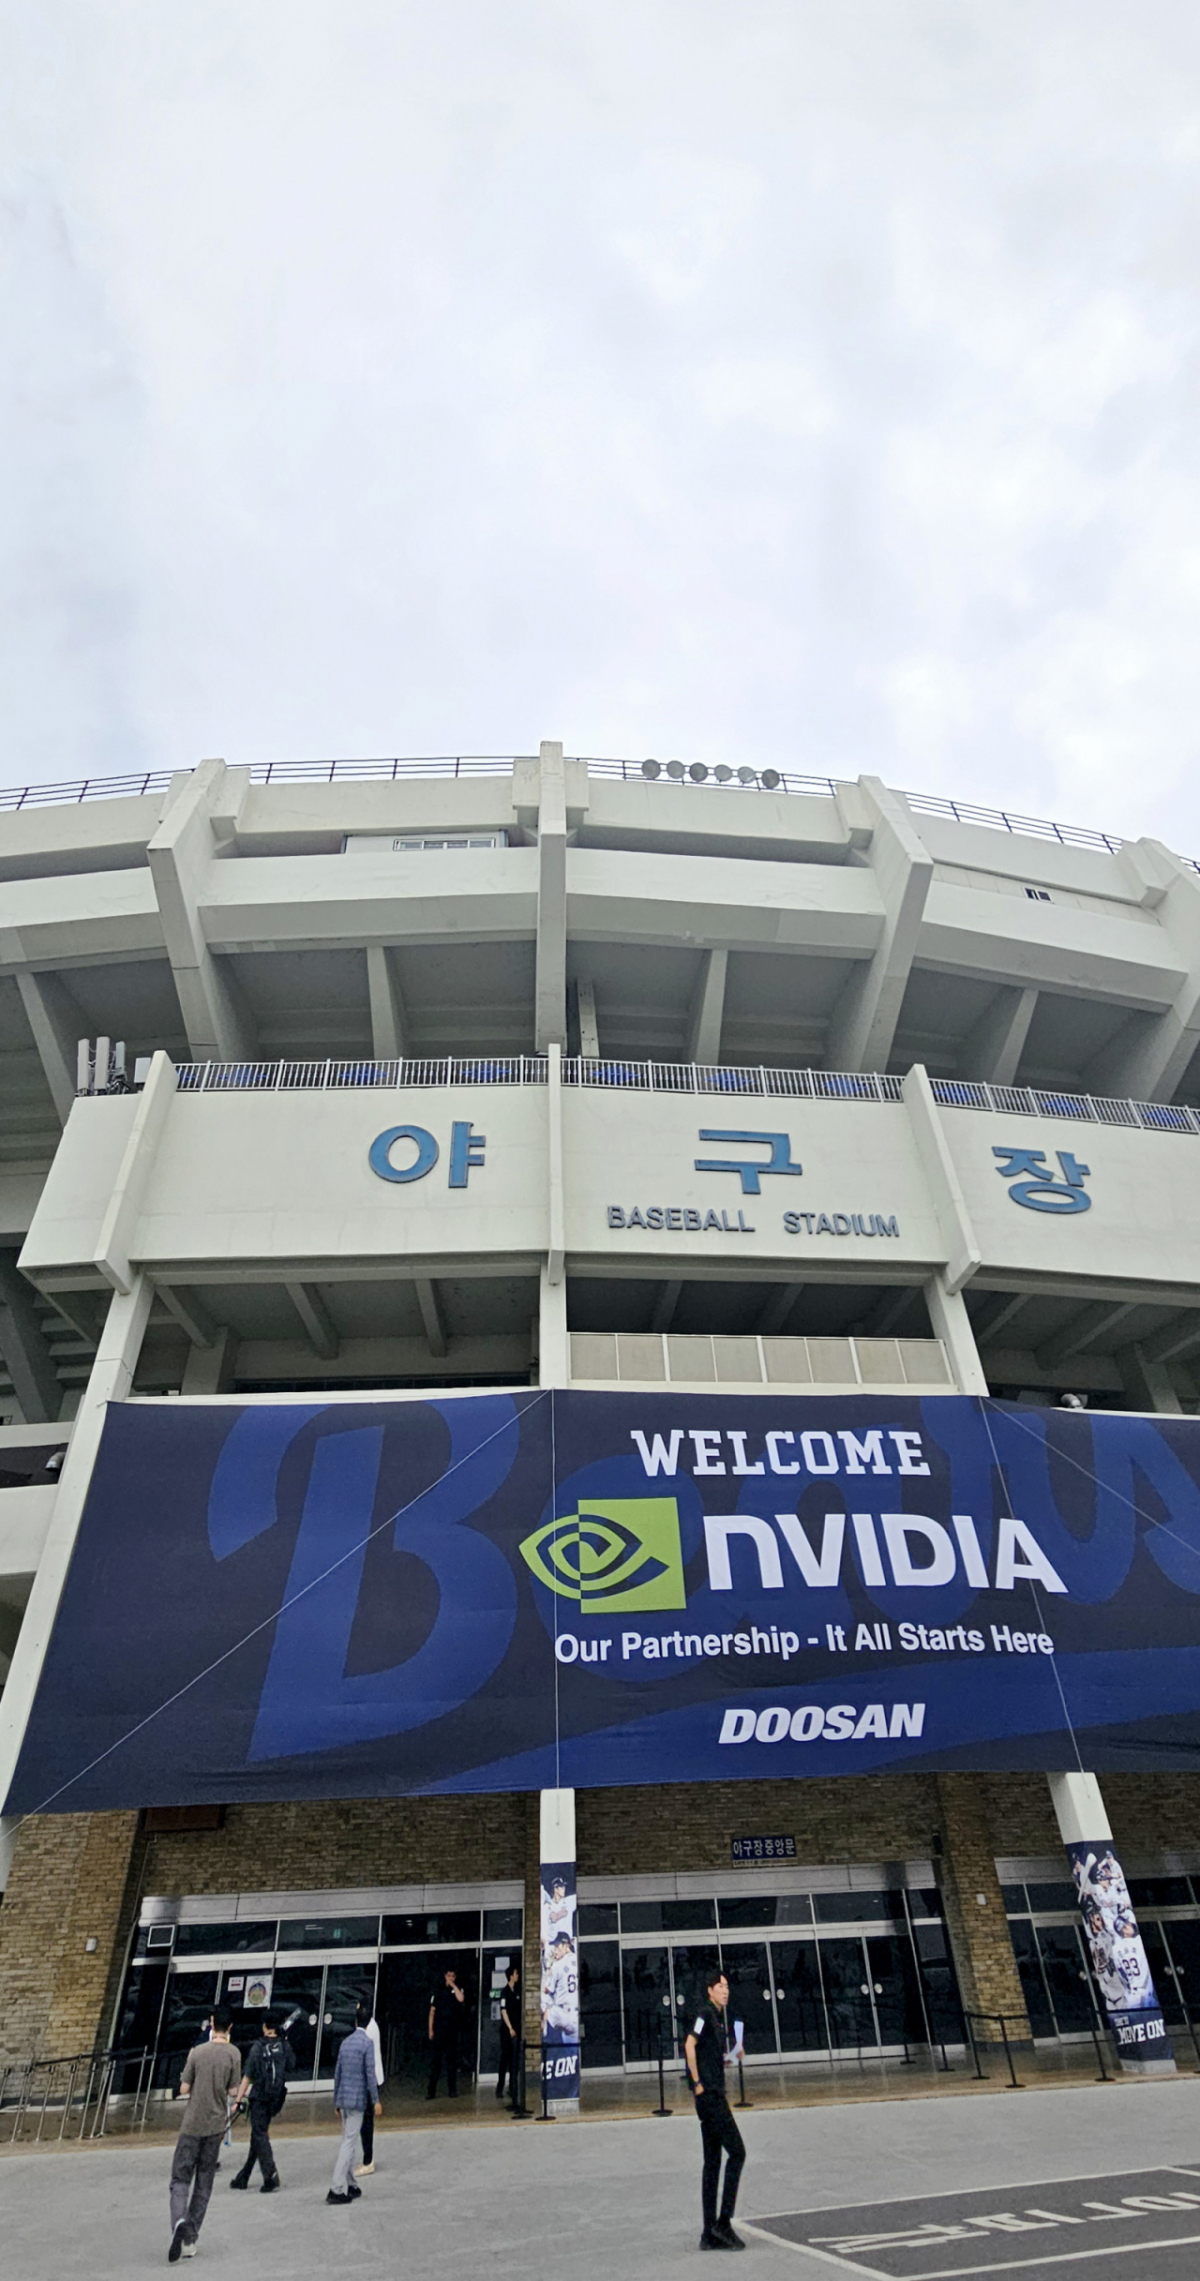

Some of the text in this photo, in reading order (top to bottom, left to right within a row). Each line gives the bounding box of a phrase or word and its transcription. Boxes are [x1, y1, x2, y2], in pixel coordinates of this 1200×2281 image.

[607, 1206, 901, 1238] BASEBALL STADIUM
[630, 1429, 931, 1477] WELCOME
[555, 1633, 612, 1663] Our
[621, 1625, 800, 1661] Partnership
[825, 1623, 848, 1652] It
[854, 1623, 892, 1651] All
[898, 1622, 986, 1652] Starts
[989, 1624, 1055, 1655] Here
[718, 1703, 926, 1744] DOOSAN
[733, 1838, 795, 1857] 야구장중앙문
[1116, 2023, 1147, 2045] MOVE
[1146, 2018, 1166, 2040] ON
[554, 2055, 578, 2078] ON
